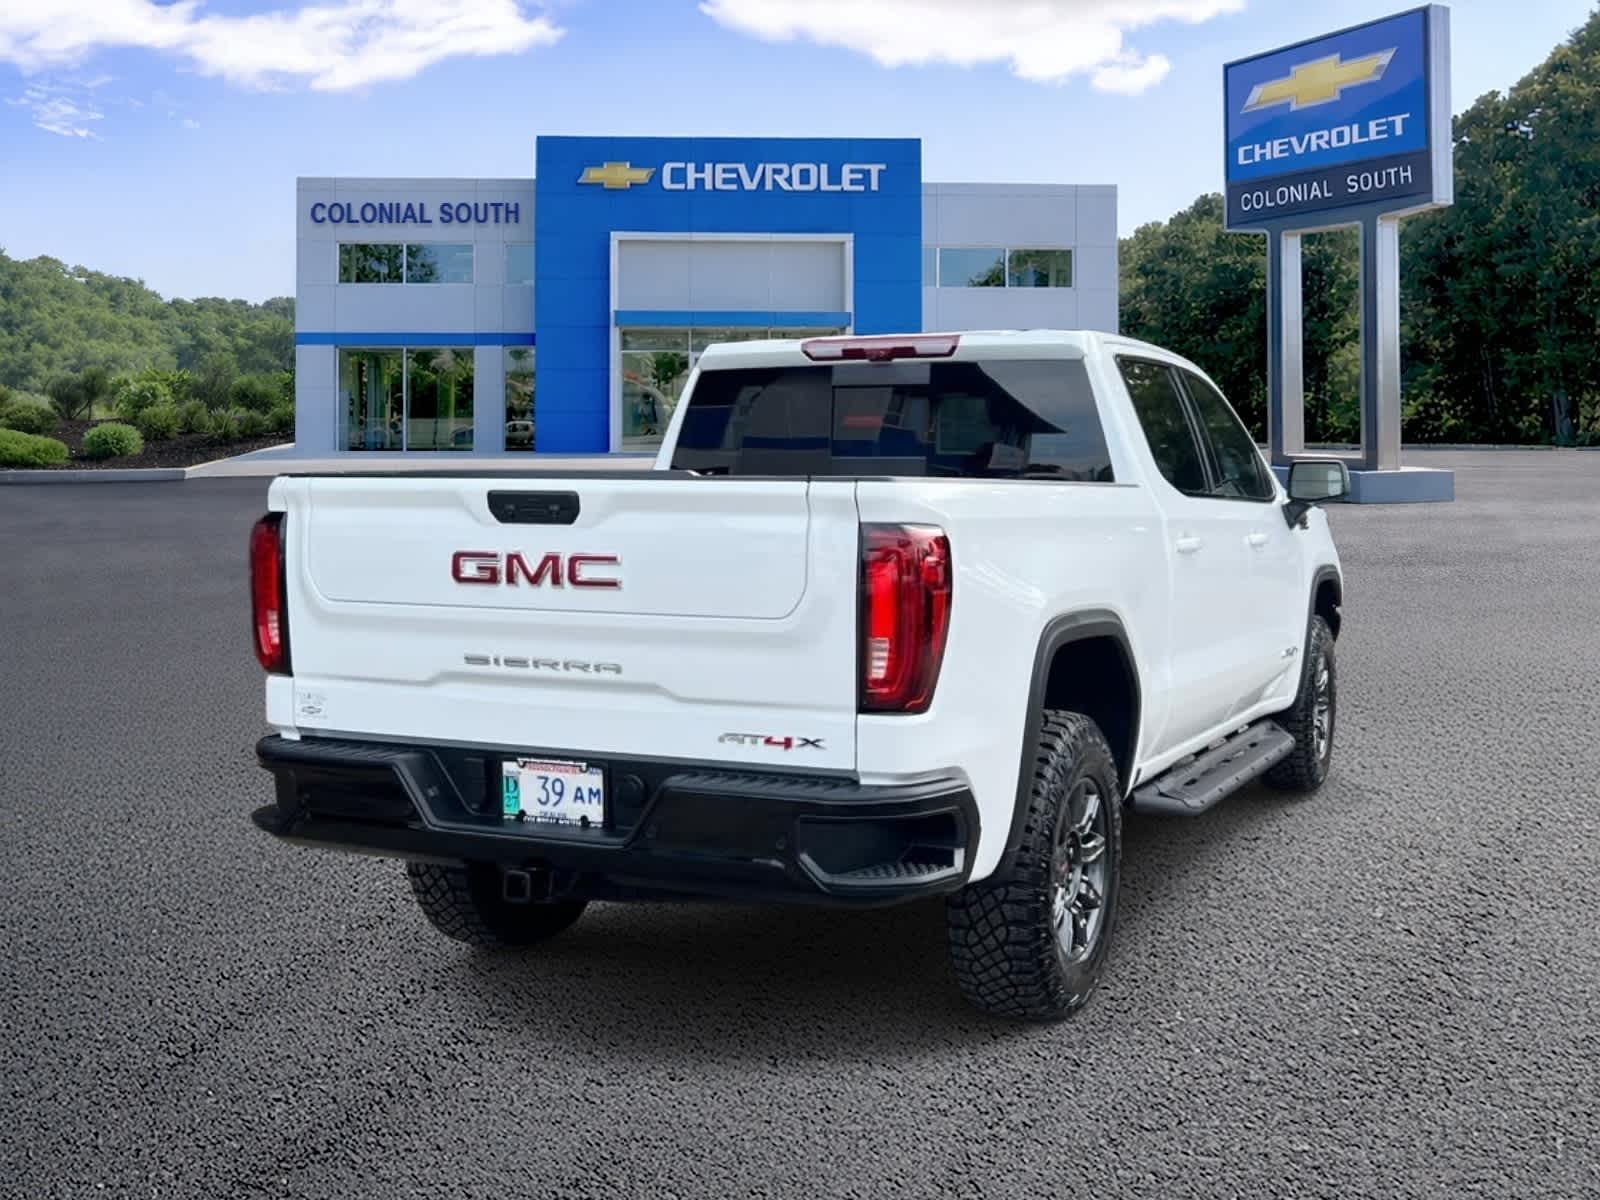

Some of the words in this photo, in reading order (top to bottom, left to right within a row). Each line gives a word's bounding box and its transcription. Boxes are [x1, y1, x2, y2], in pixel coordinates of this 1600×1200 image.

[1238, 112, 1410, 165] CHEVROLET
[662, 162, 887, 191] CHEVROLET
[1240, 180, 1333, 211] COLONIAL
[1346, 165, 1413, 194] SOUTH
[310, 202, 433, 225] COLONIAL
[439, 202, 520, 225] SOUTH
[452, 551, 622, 591] GMC
[463, 653, 622, 675] SIERRA
[536, 776, 565, 807] 39
[573, 786, 602, 805] AM
